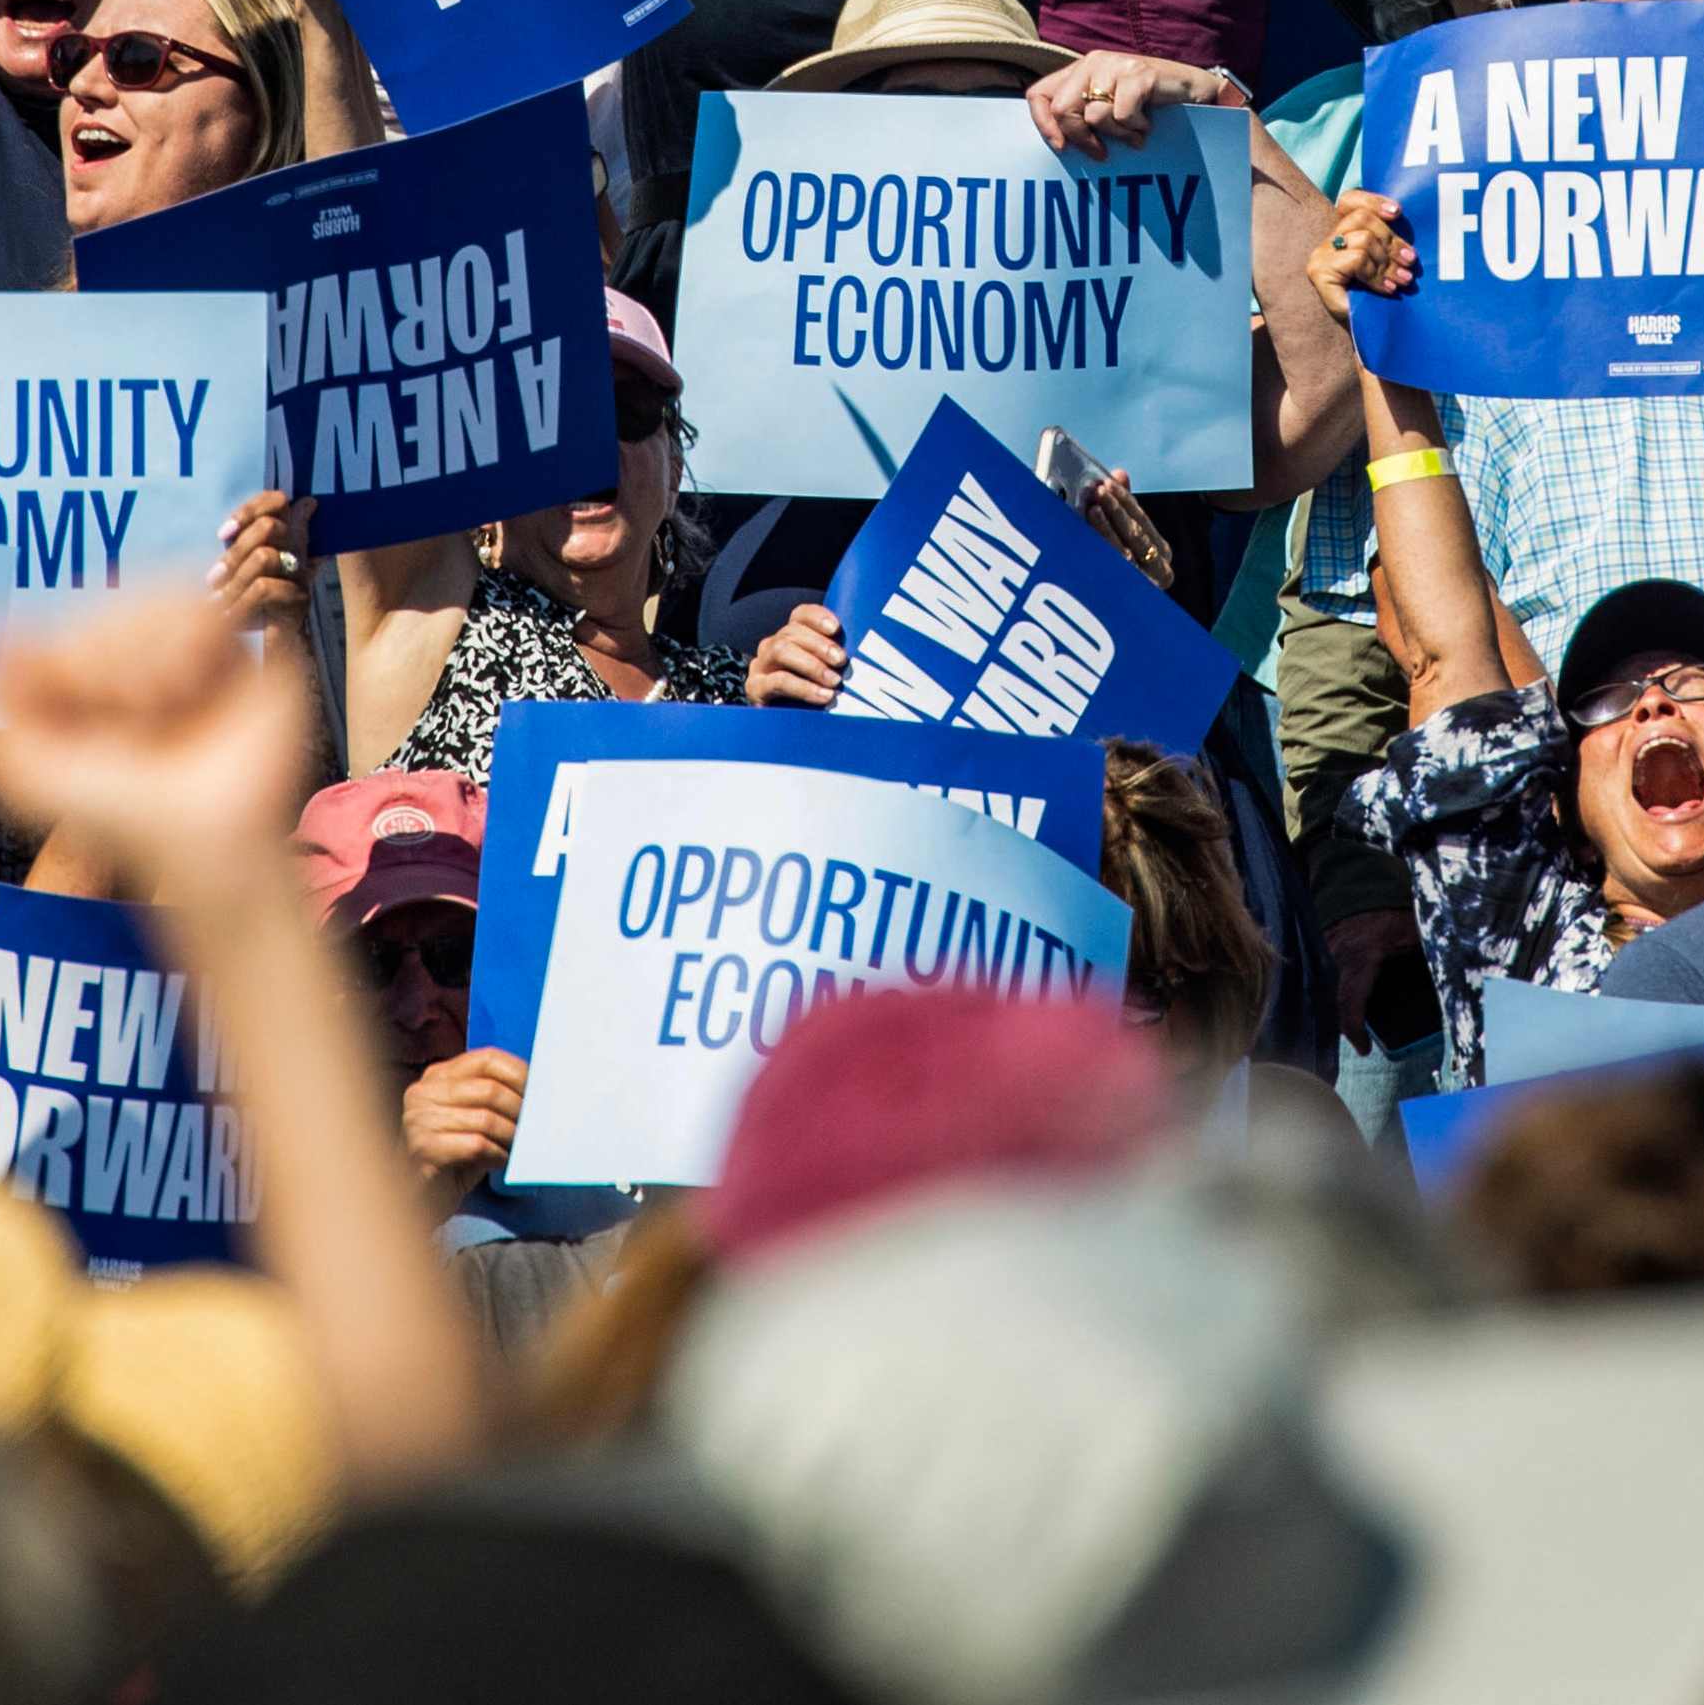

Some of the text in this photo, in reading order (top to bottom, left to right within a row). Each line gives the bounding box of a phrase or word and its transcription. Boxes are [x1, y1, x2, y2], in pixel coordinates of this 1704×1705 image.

[1403, 70, 1464, 167] A
[1487, 55, 1687, 163] NEW
[312, 213, 360, 240] HARRIS
[320, 204, 352, 221] WALZ
[741, 170, 1200, 272] OPPORTUNITY
[268, 229, 532, 396] FORWA
[794, 275, 1133, 373] ECONOMY
[1627, 314, 1682, 335] HARRIS
[1636, 333, 1674, 345] WALZ
[311, 337, 562, 496] A NEW
[881, 471, 1041, 665] WAY
[620, 844, 1092, 1006] OPPORTUNITY
